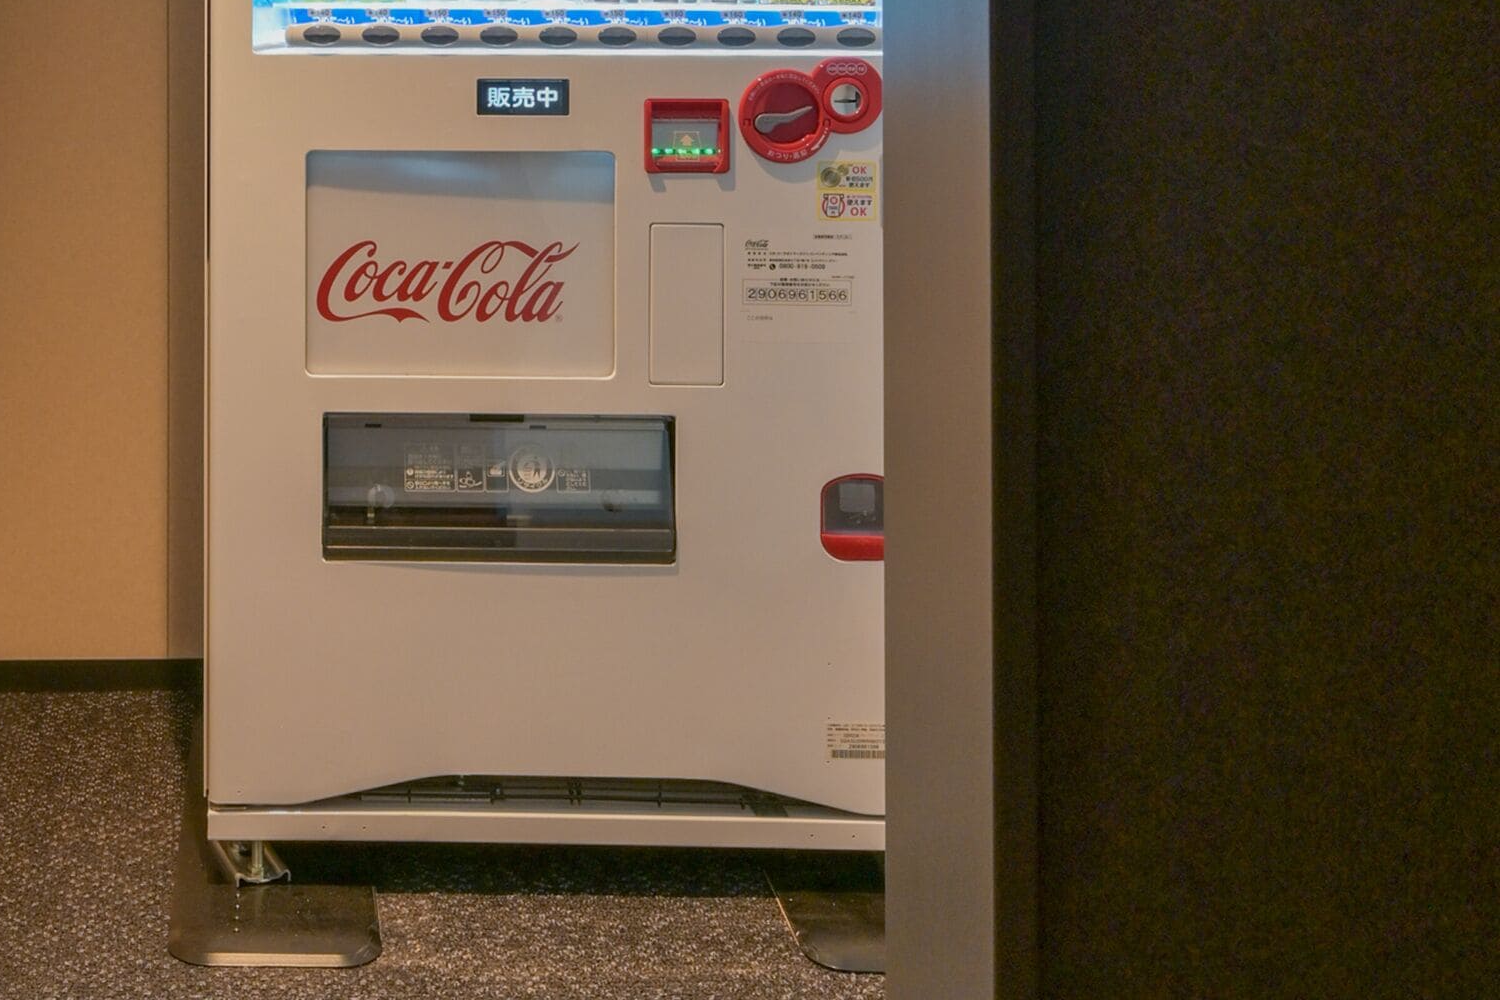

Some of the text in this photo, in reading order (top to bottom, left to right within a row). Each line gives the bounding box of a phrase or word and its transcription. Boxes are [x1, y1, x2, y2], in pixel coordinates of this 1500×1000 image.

[487, 86, 558, 108] 販売中
[852, 166, 868, 174] OK
[850, 207, 868, 216] OK
[316, 240, 580, 323] Coca-Cola
[748, 288, 847, 300] 2906961566
